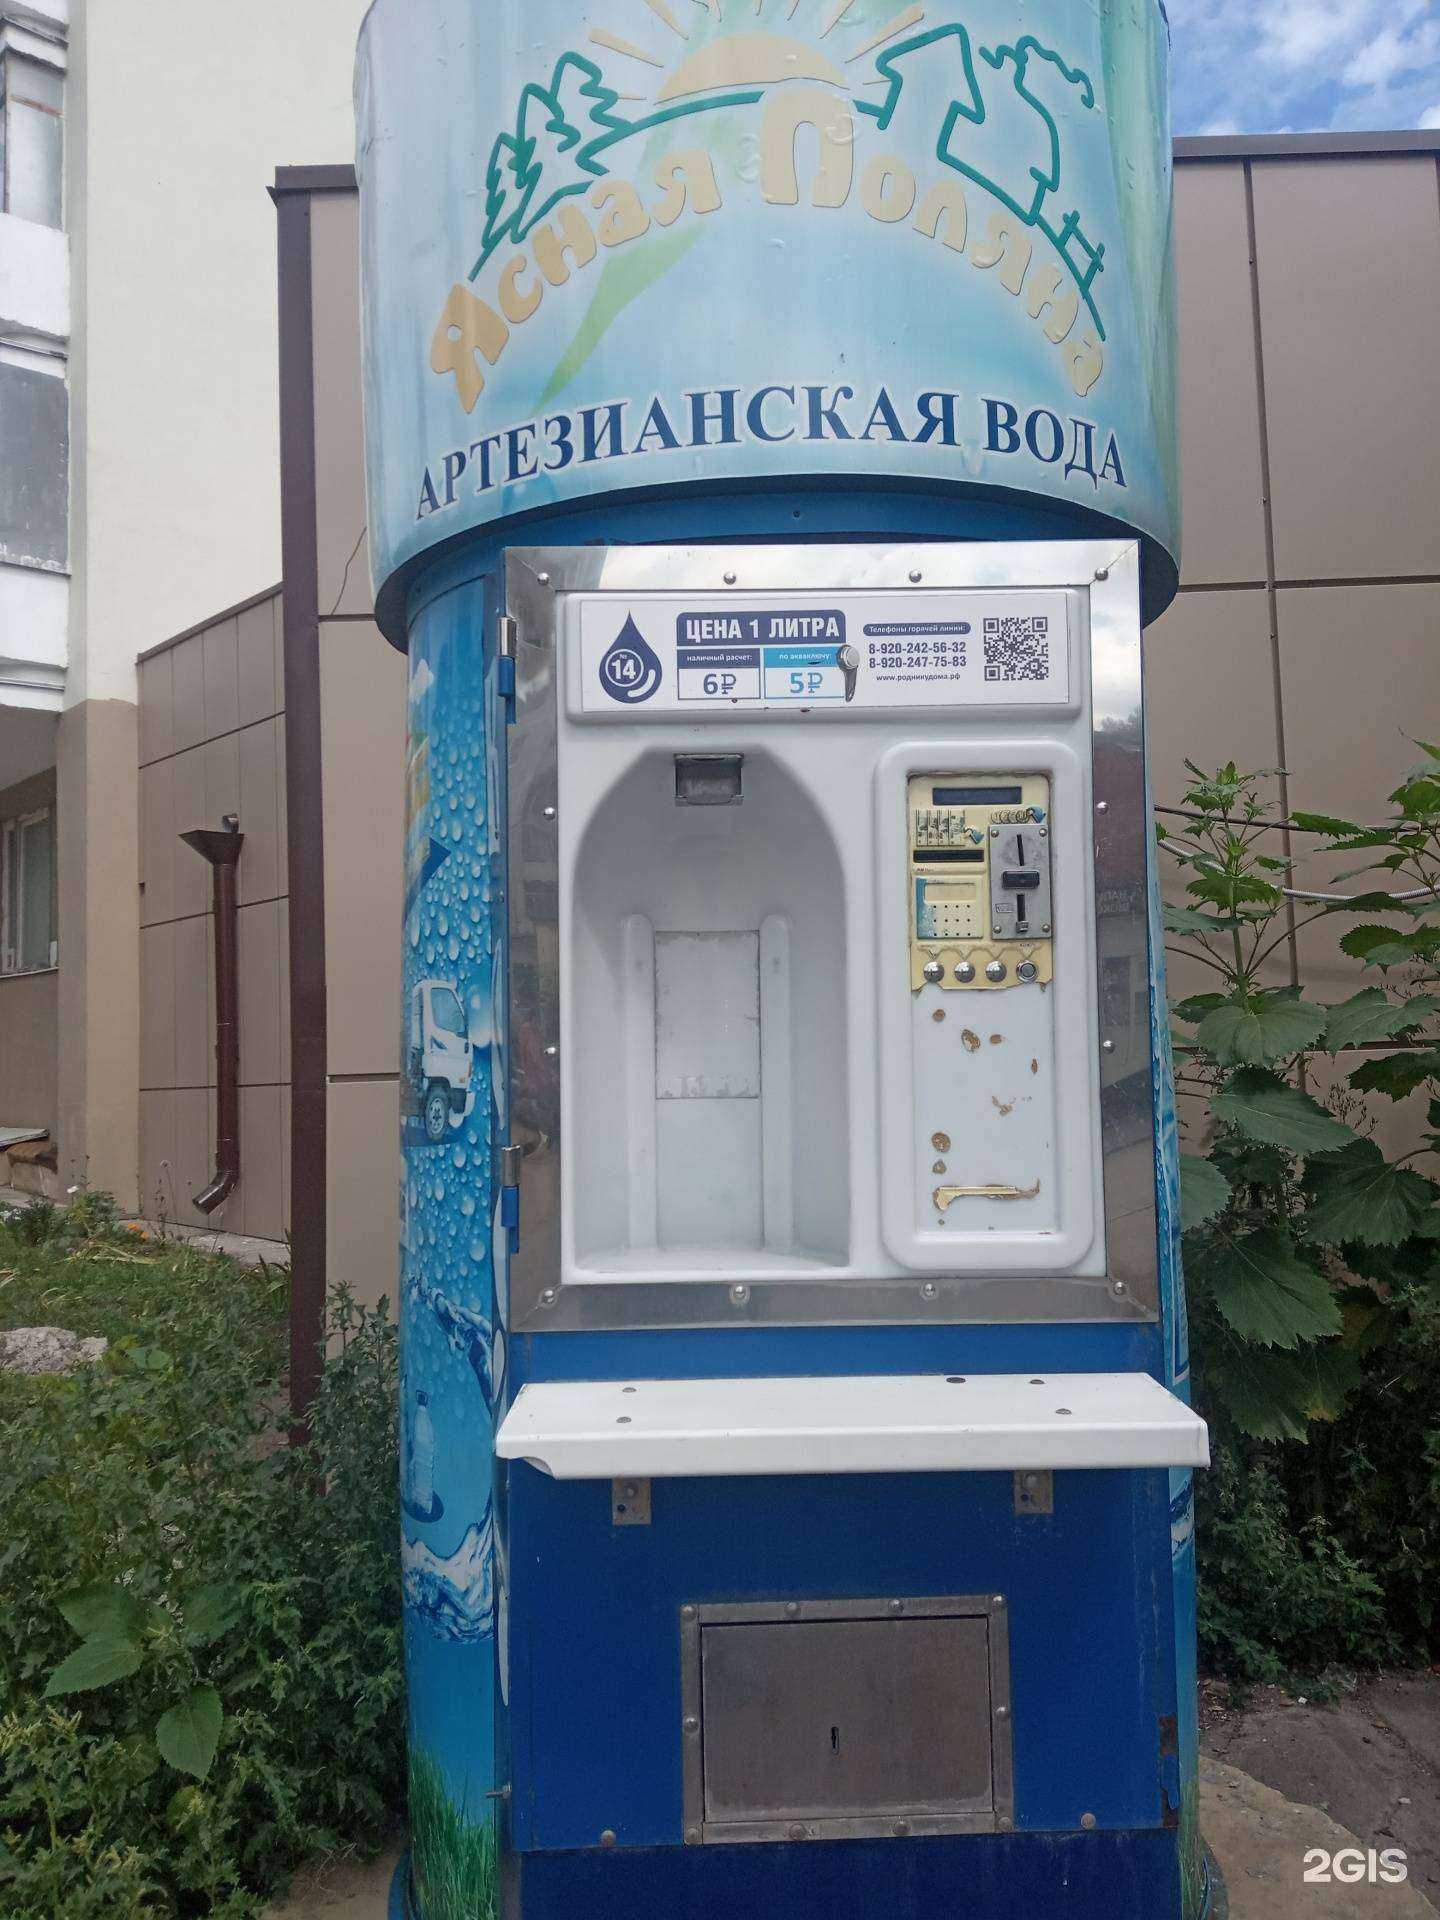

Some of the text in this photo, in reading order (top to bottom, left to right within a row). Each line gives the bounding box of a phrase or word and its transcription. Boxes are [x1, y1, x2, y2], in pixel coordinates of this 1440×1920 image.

[430, 147, 723, 415] Ясная
[415, 385, 1129, 521] АРТЕЗИАНСКАЯ ВОДА
[686, 616, 840, 643] ЦЕНА 1 ЛИТРА
[869, 626, 907, 634] Телефоны
[908, 625, 938, 633] горячей
[868, 641, 967, 655] 8-920-242-56-32
[686, 653, 753, 663] наличный расчет:
[868, 655, 967, 669] 8-920-247-75-83
[611, 659, 637, 680] 14
